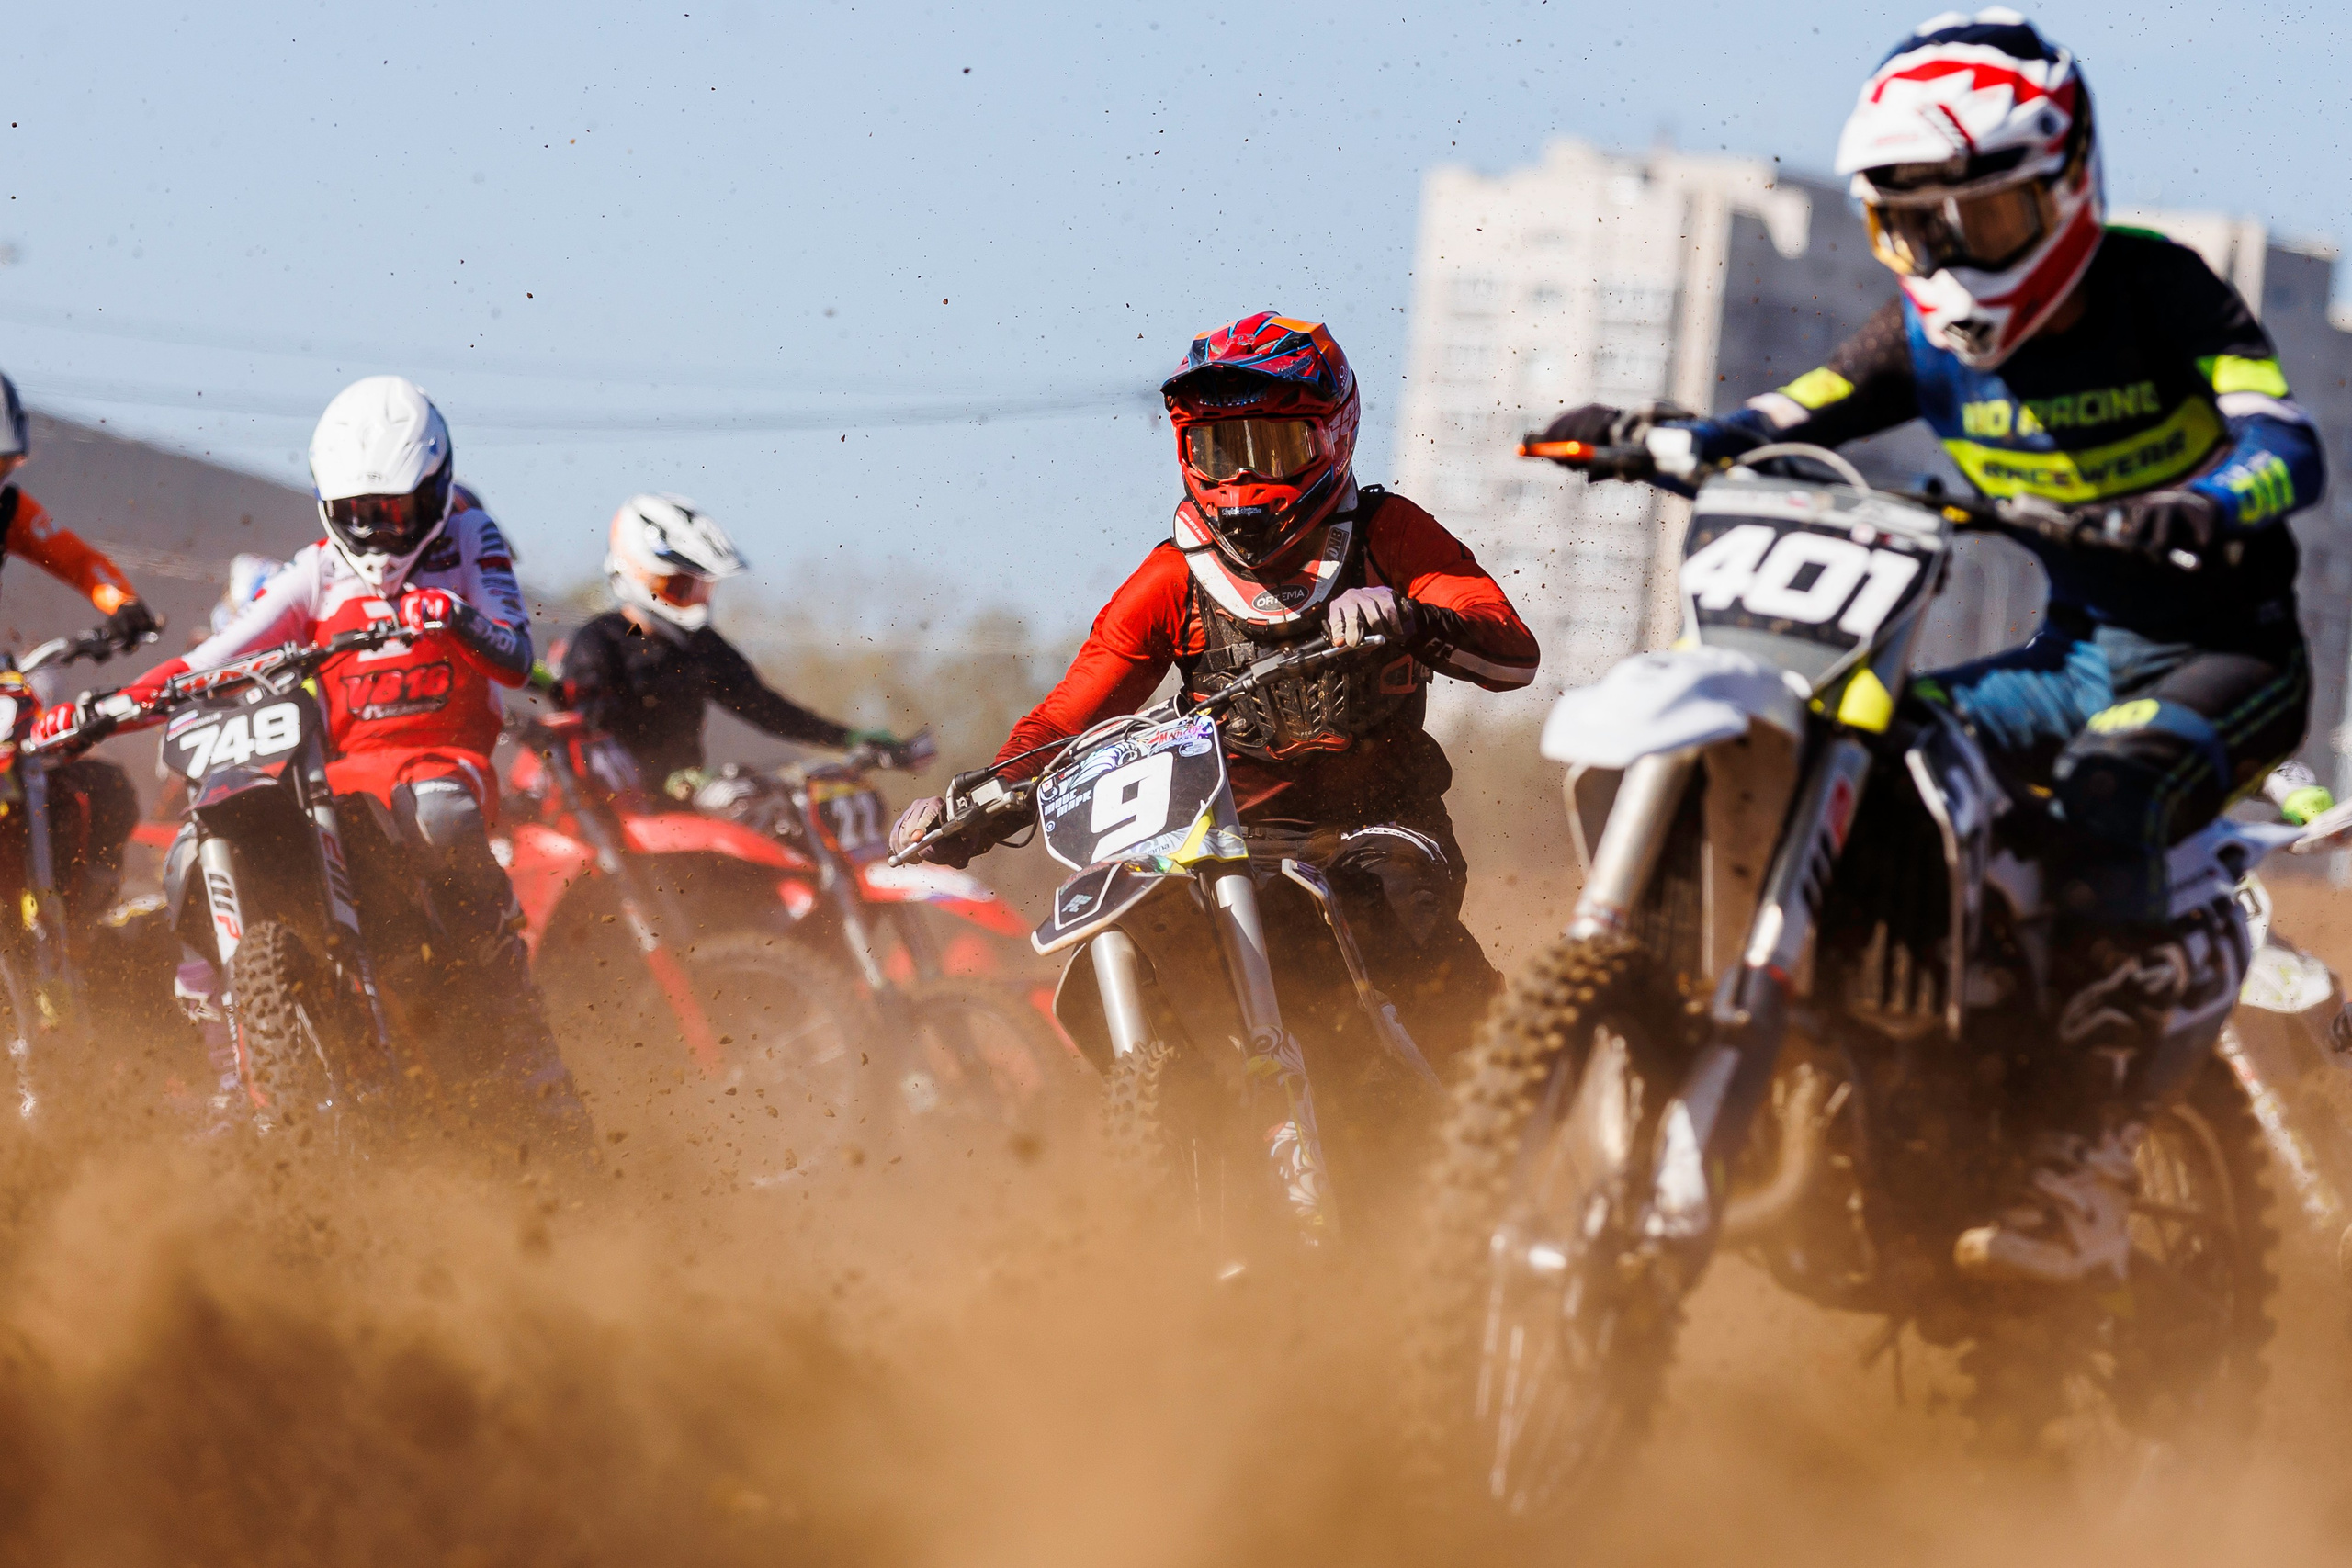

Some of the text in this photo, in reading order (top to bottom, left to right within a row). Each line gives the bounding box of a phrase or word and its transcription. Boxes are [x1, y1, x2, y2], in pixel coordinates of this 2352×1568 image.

[1256, 588, 1305, 607] ORTEMA
[1679, 524, 1921, 636] 401
[1091, 751, 1174, 865] 9
